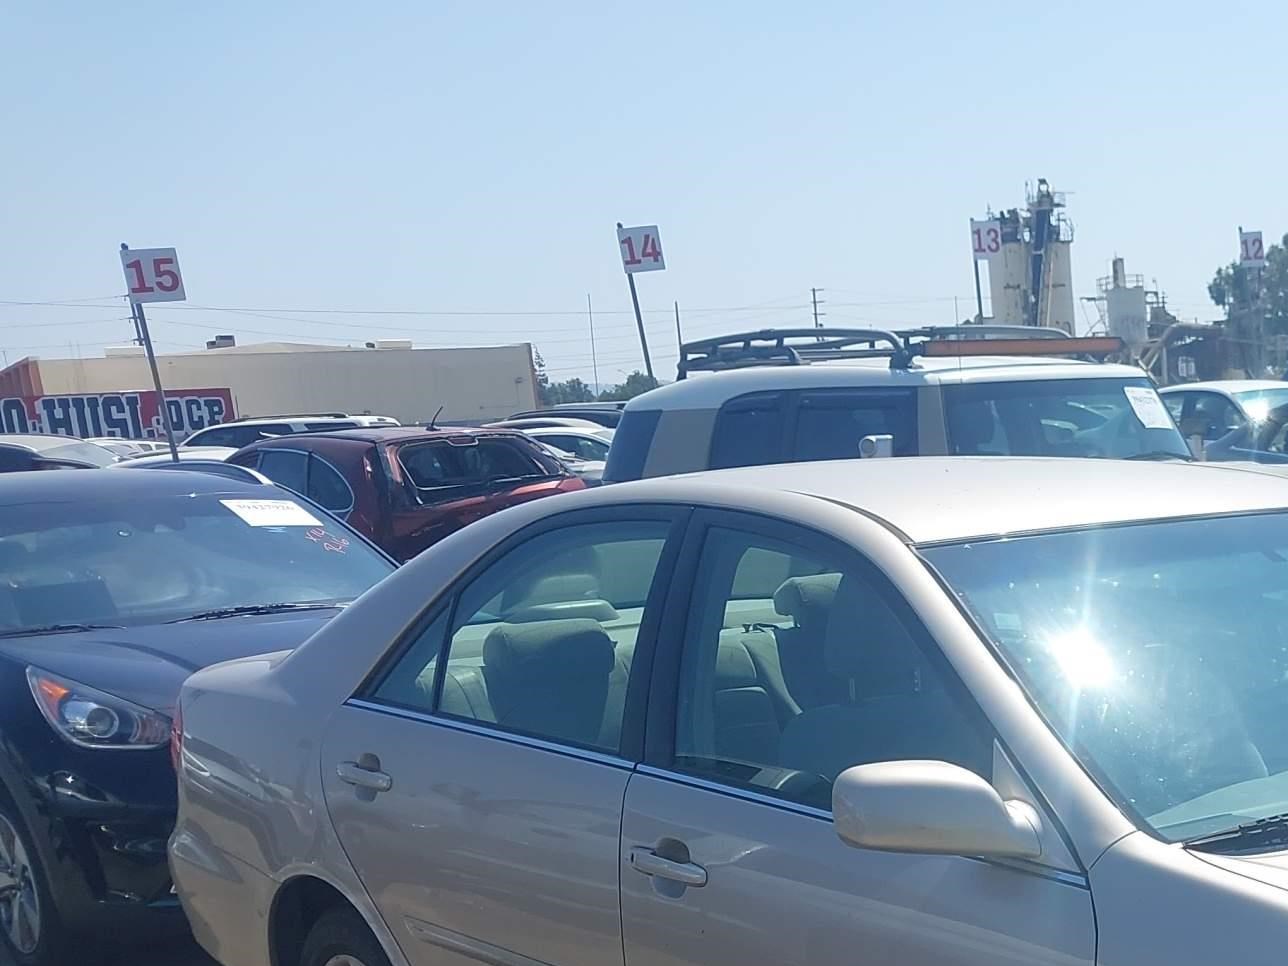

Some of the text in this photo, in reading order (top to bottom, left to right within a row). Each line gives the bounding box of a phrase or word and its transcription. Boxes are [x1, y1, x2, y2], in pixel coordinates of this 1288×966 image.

[621, 234, 660, 265] 14
[973, 228, 1000, 253] 13
[1241, 238, 1264, 260] 12
[126, 257, 180, 294] 15
